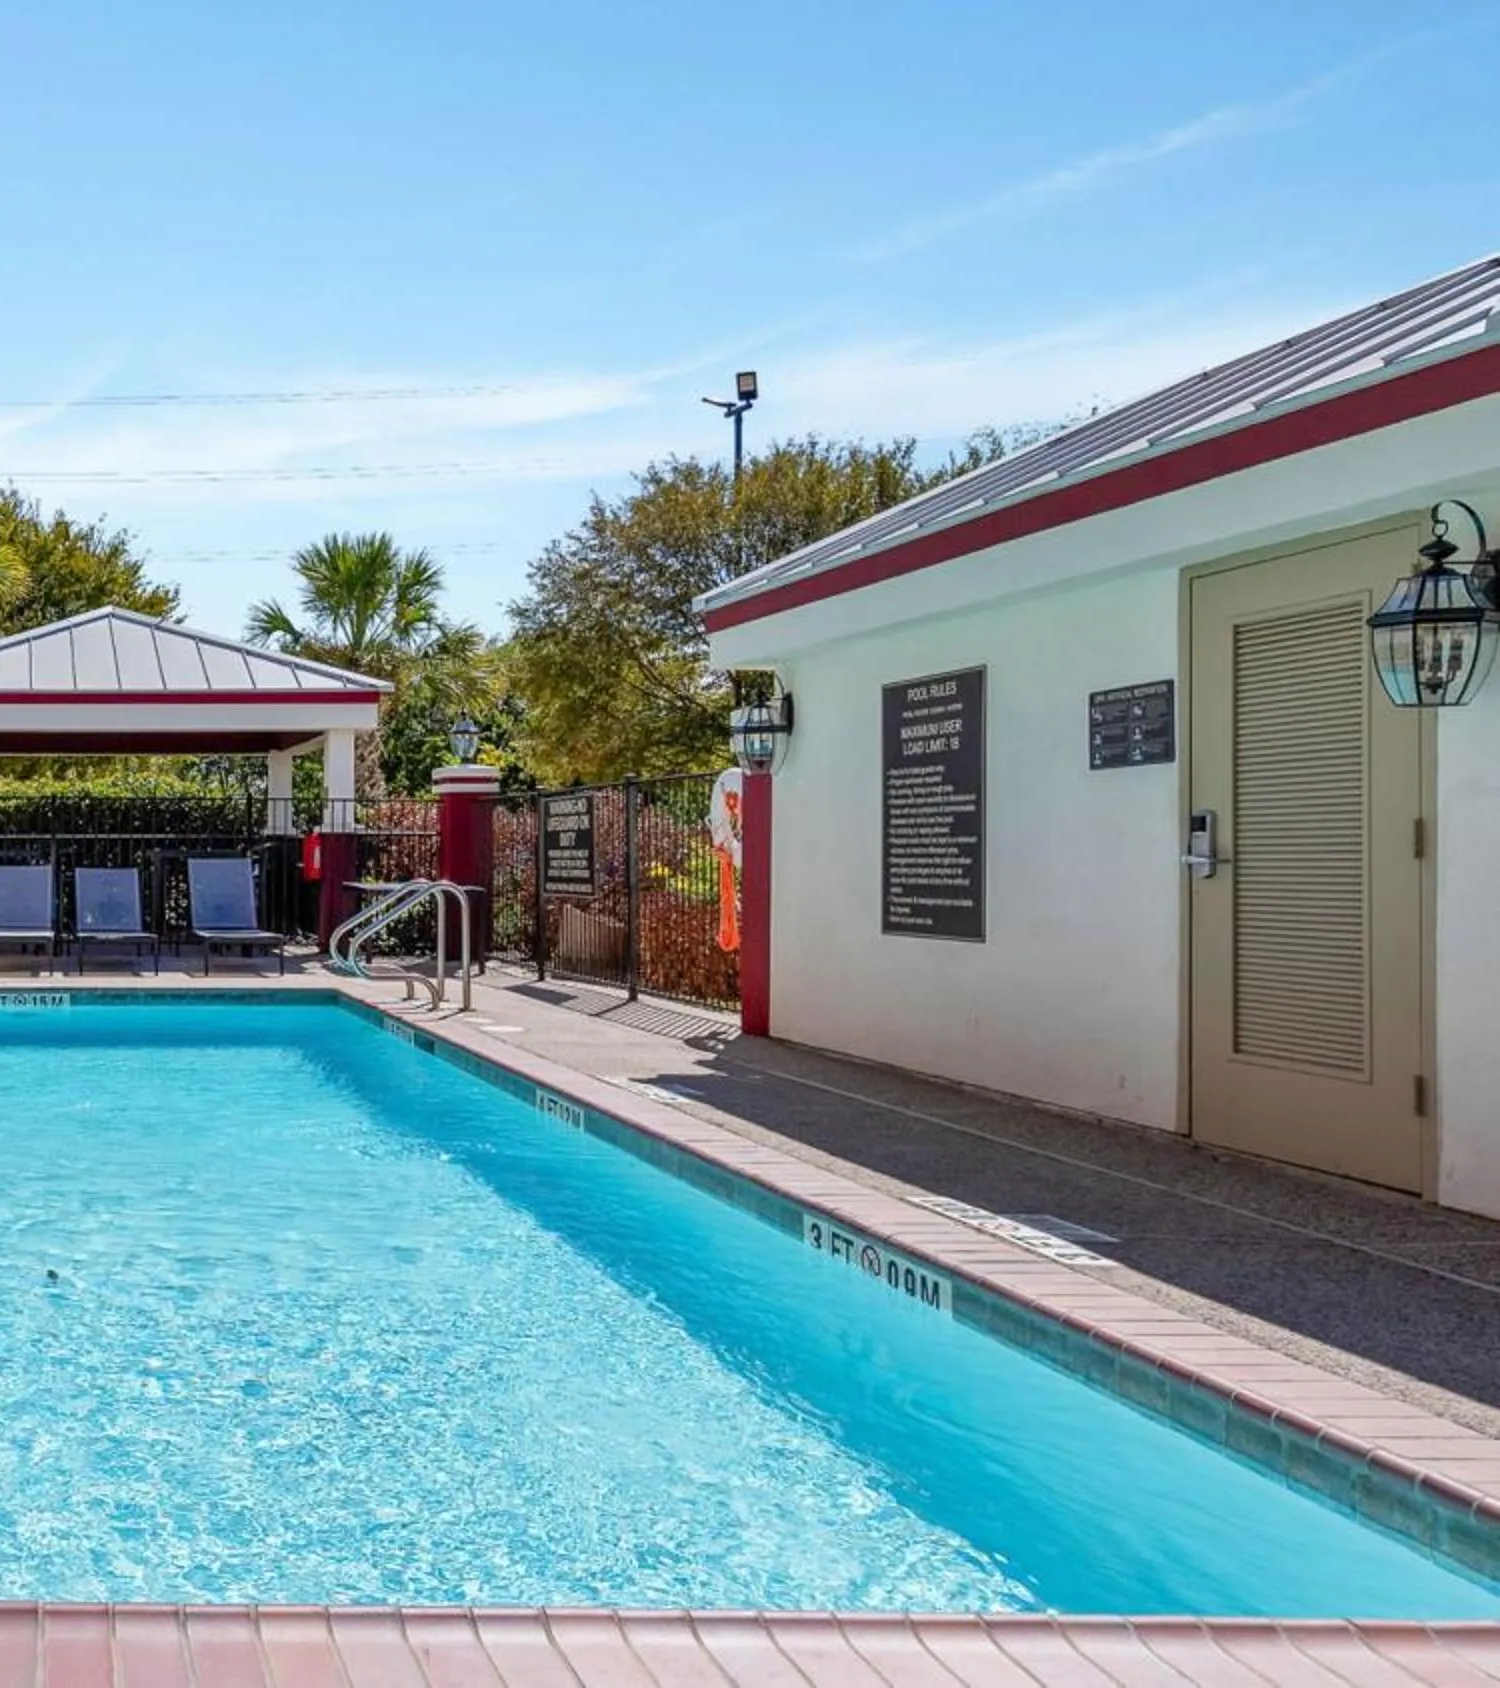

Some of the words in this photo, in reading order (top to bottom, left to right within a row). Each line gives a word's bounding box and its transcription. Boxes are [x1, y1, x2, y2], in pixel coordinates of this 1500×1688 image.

[907, 687, 928, 701] POOL
[929, 681, 957, 697] RULES
[810, 1222, 822, 1249] 3
[831, 1231, 854, 1264] FT
